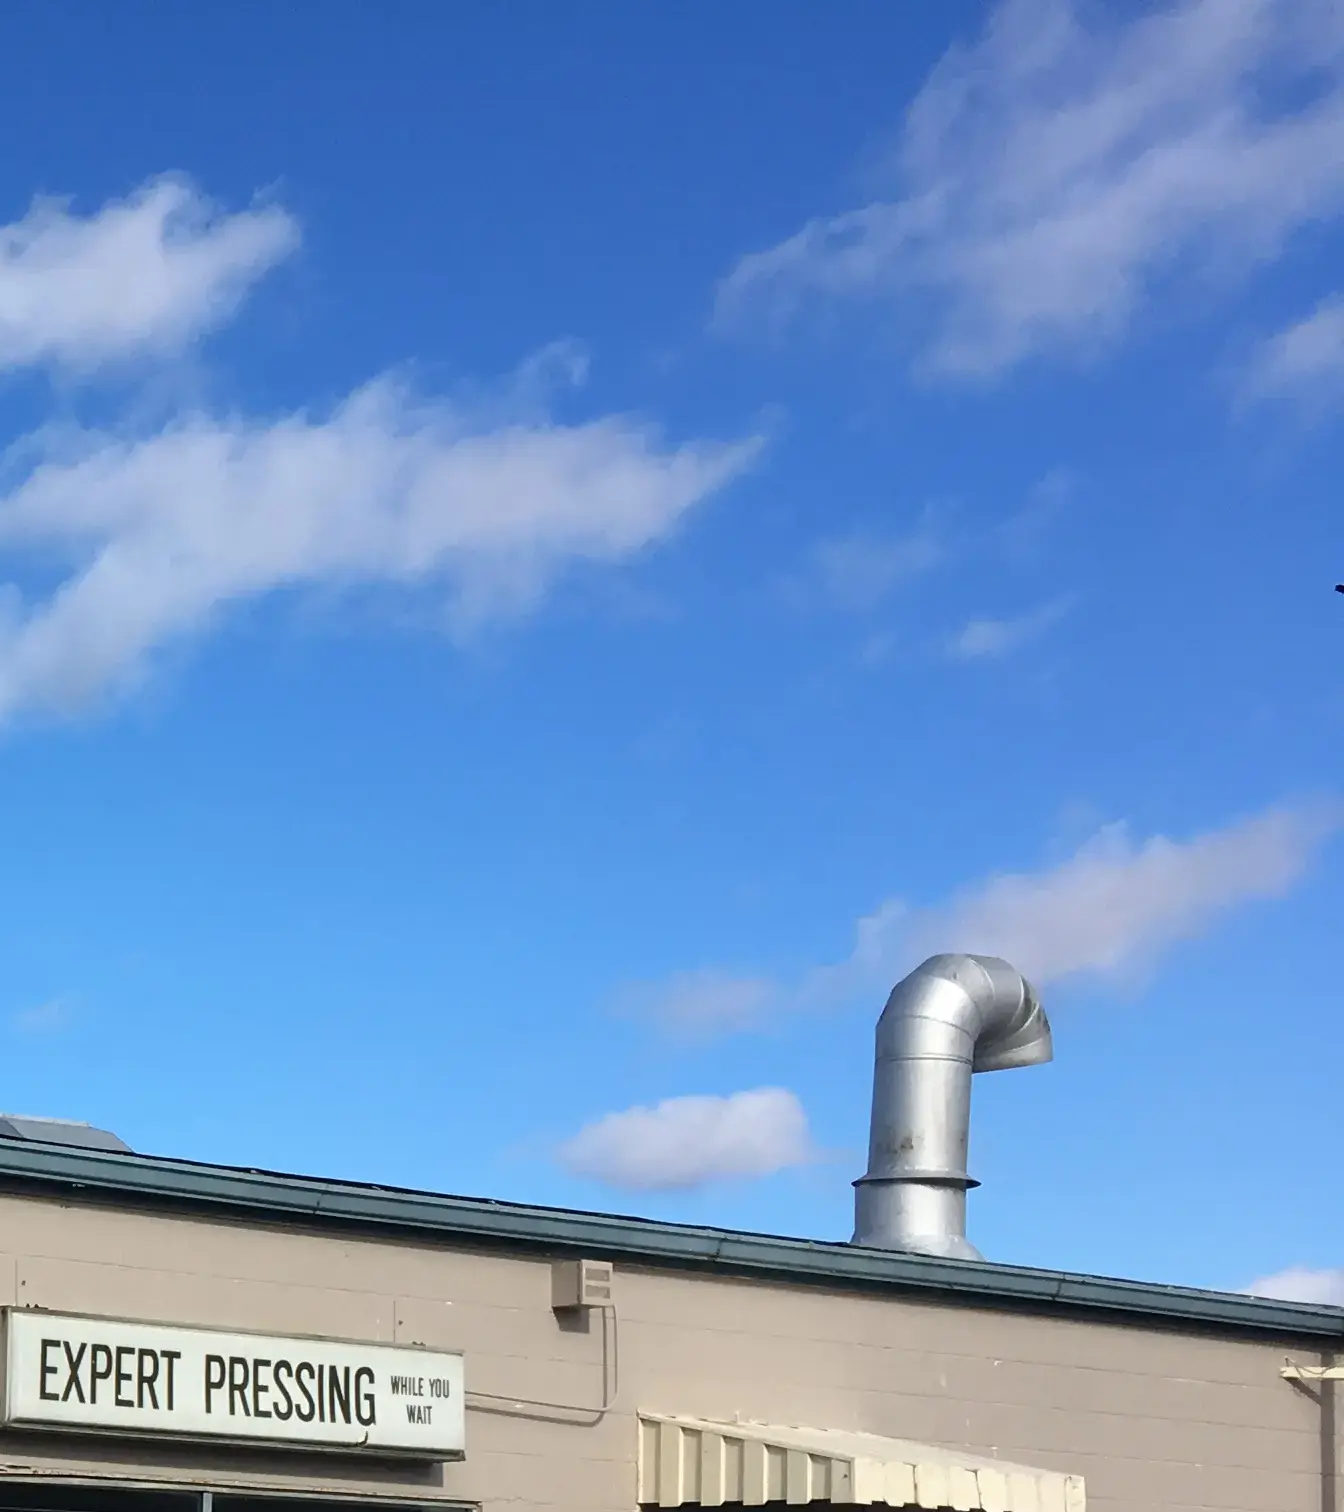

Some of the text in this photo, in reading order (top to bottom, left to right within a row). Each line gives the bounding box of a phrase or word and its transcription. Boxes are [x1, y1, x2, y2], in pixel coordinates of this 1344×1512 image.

[39, 1338, 377, 1426] EXPERT PRESSING
[391, 1375, 450, 1399] WHILE YOU
[406, 1404, 432, 1425] WAIT
